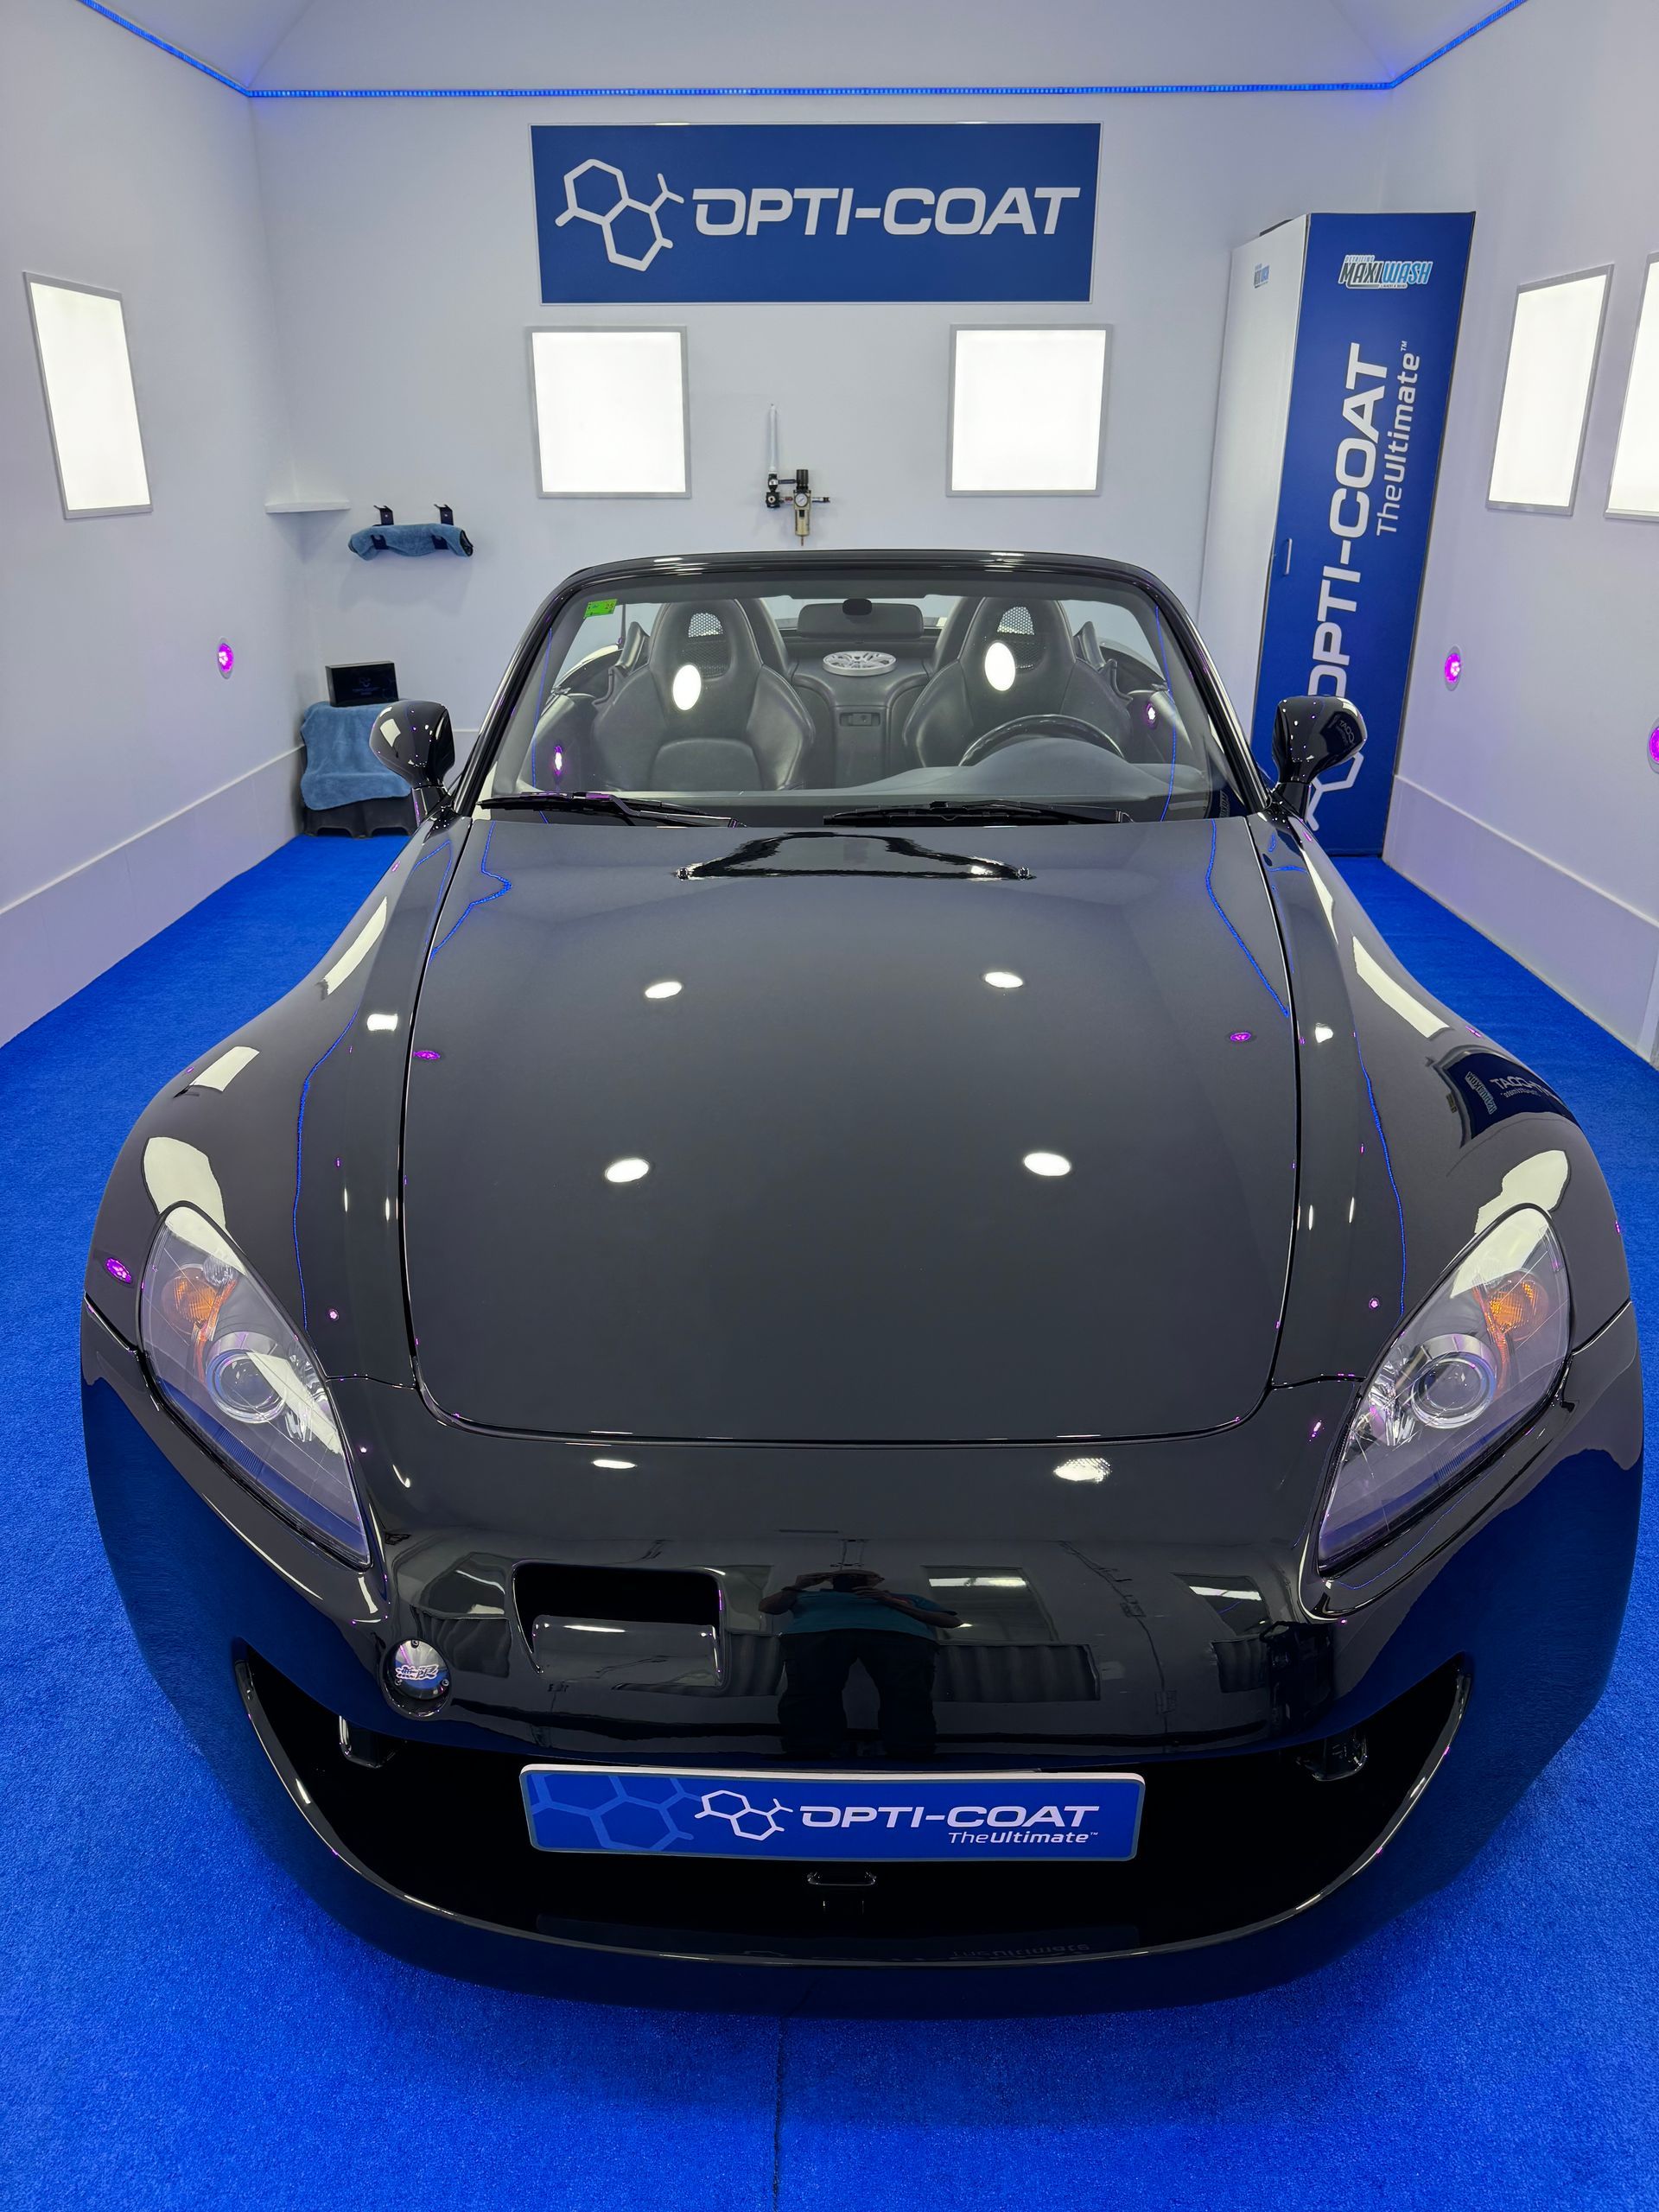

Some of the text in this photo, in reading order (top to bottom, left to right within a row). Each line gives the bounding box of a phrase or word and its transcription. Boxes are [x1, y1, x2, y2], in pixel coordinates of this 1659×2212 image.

[692, 187, 1081, 236] OPTI-COAT
[1338, 261, 1433, 285] MAXIWASH
[799, 1805, 1100, 1828] OPTI-COAT
